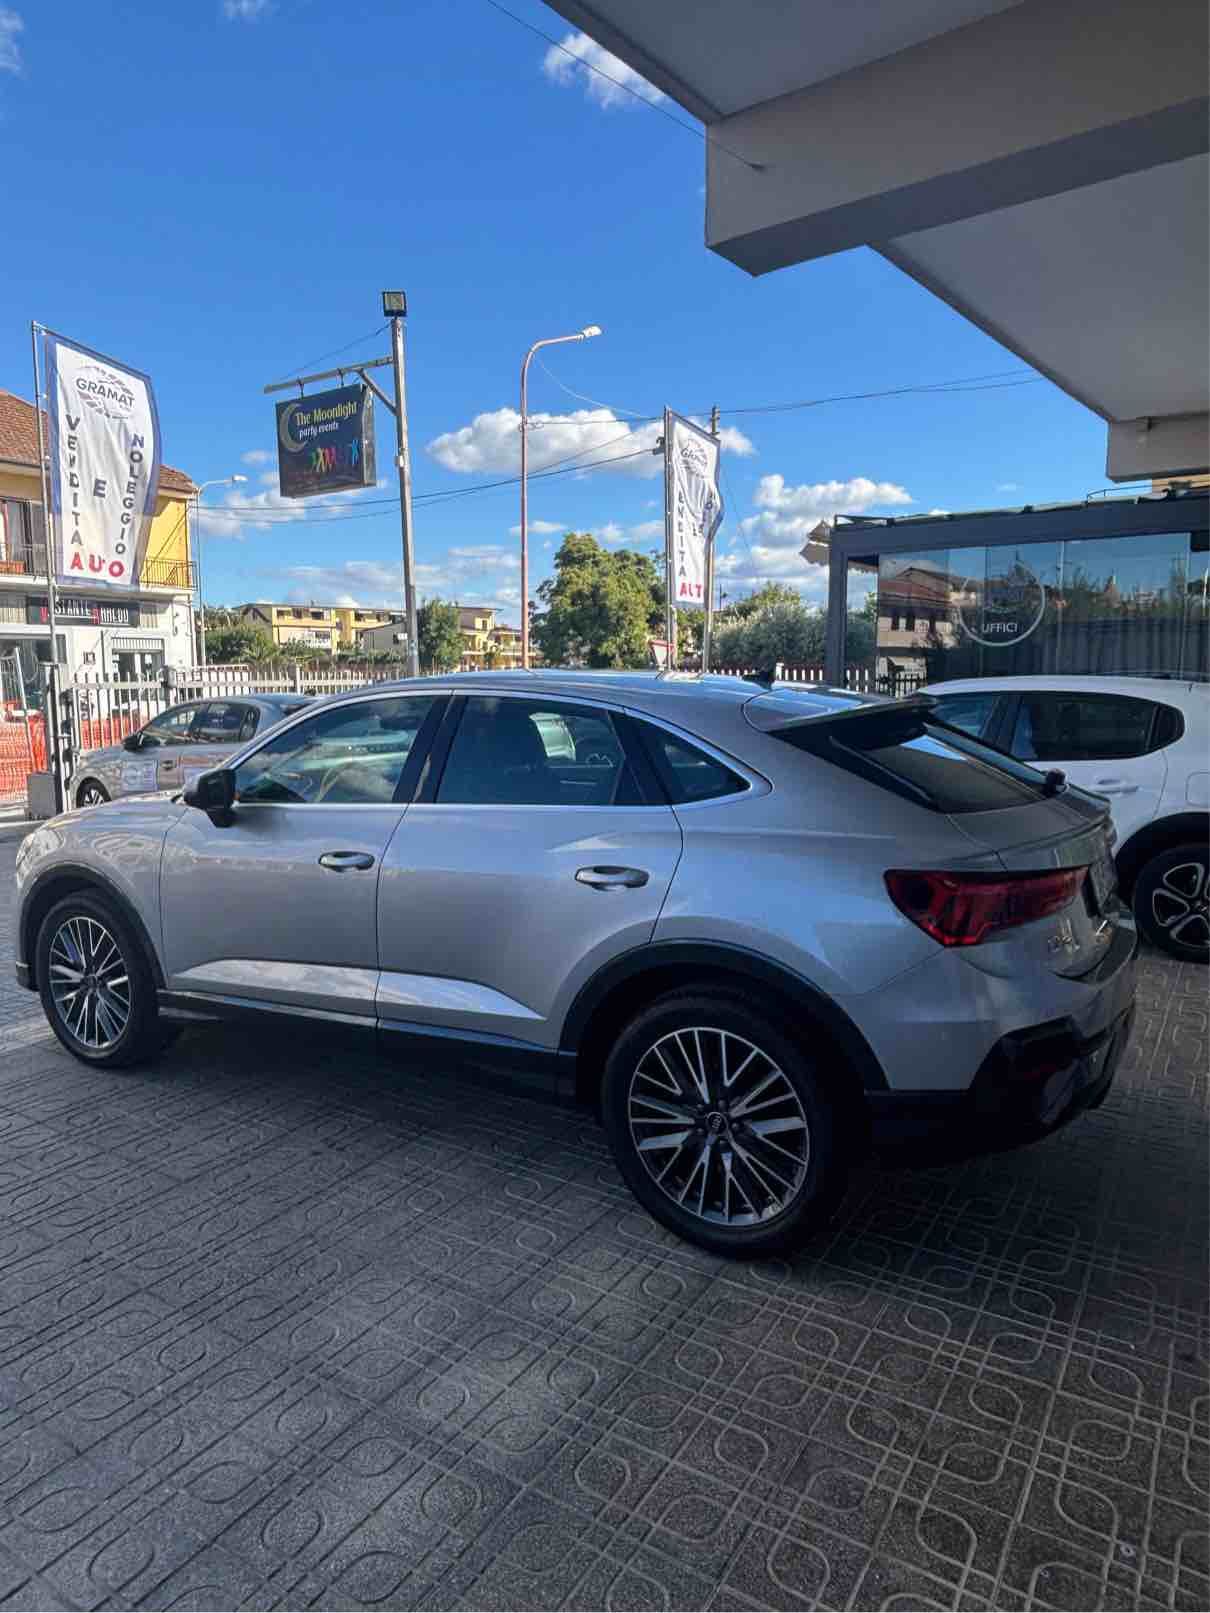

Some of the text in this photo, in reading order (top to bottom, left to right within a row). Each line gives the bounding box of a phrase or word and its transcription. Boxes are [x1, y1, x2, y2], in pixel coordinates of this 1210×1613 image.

[296, 400, 357, 426] The Moonlight
[299, 424, 318, 440] party
[93, 478, 107, 498] E
[115, 434, 145, 555] NOLEGGIO
[982, 622, 1018, 633] UFFICI
